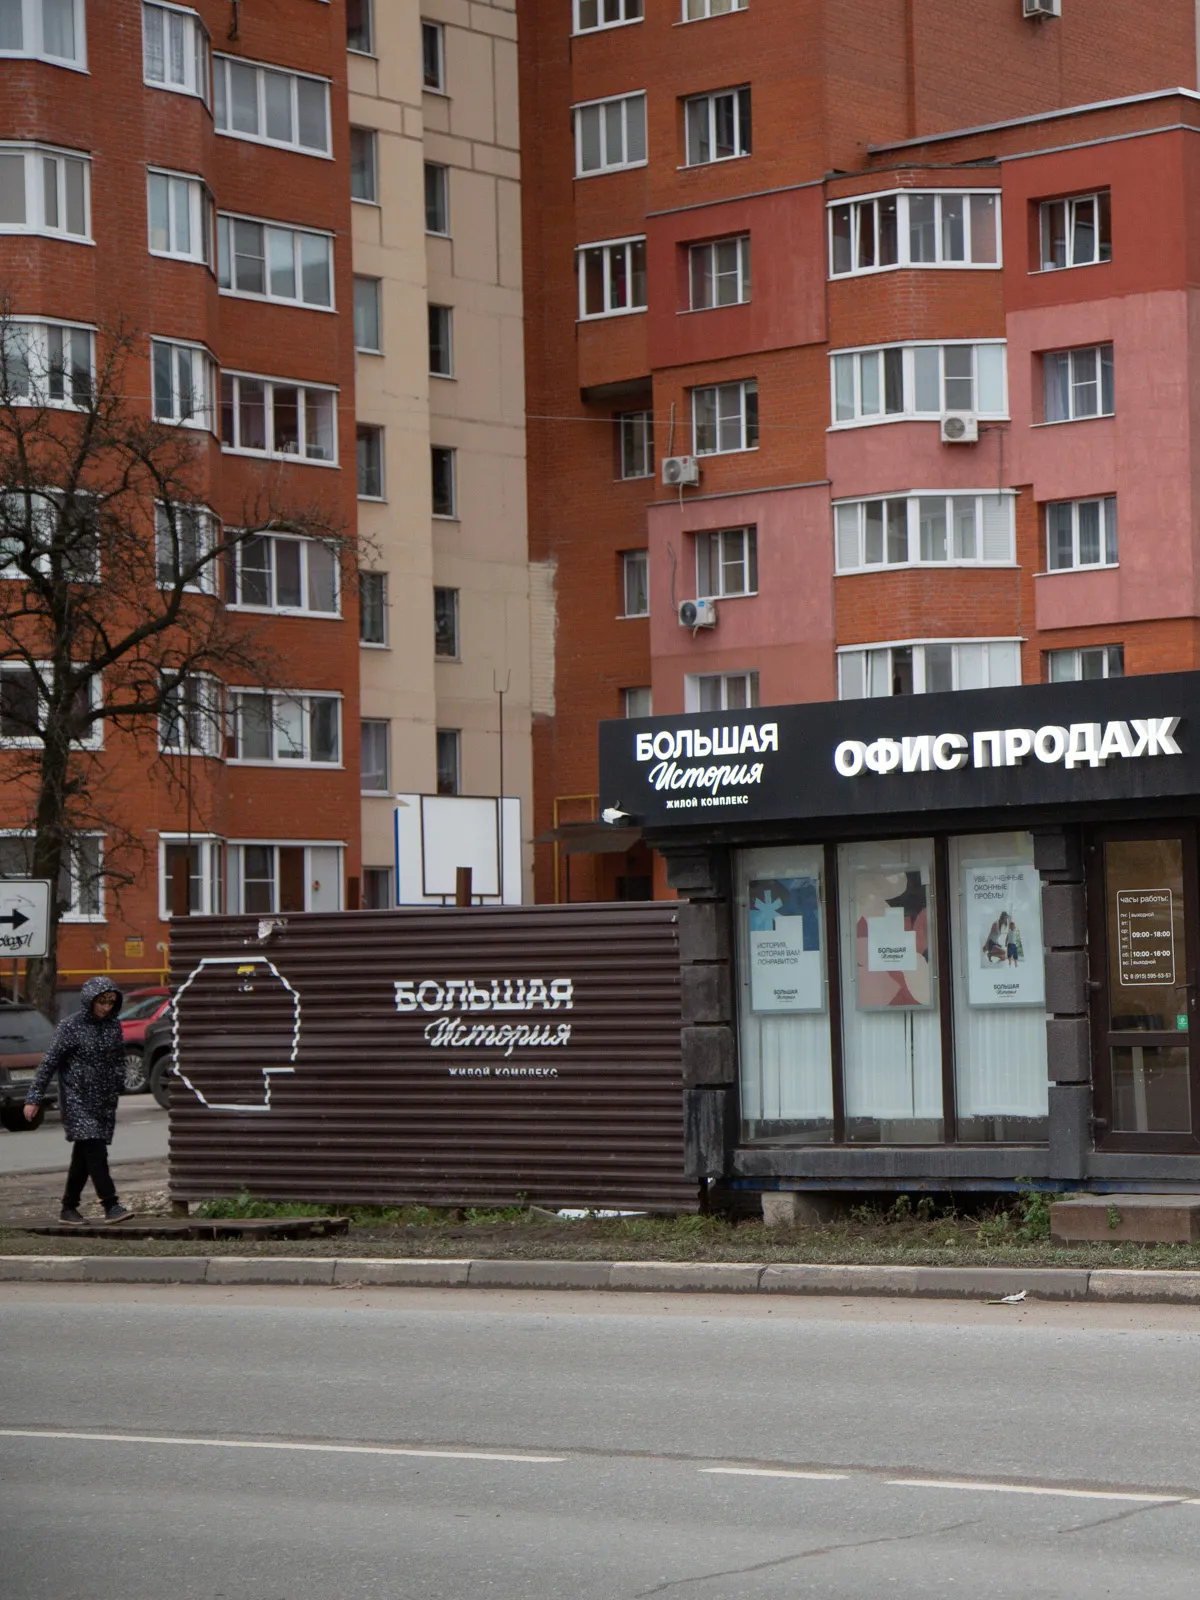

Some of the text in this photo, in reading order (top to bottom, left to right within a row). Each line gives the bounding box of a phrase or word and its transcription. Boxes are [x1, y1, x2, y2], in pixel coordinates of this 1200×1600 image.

[636, 723, 778, 761] БОЛЬШАЯ
[834, 716, 1181, 777] ОФИС ПРОДАЖ
[648, 761, 764, 795] История
[666, 795, 749, 809] ЖИЛОЙ КОМПЛЕКС
[394, 979, 573, 1011] БОЛЬШАЯ
[424, 1017, 571, 1057] История
[449, 1066, 558, 1078] ЖИЛОЙ КОМПЛЕКС
